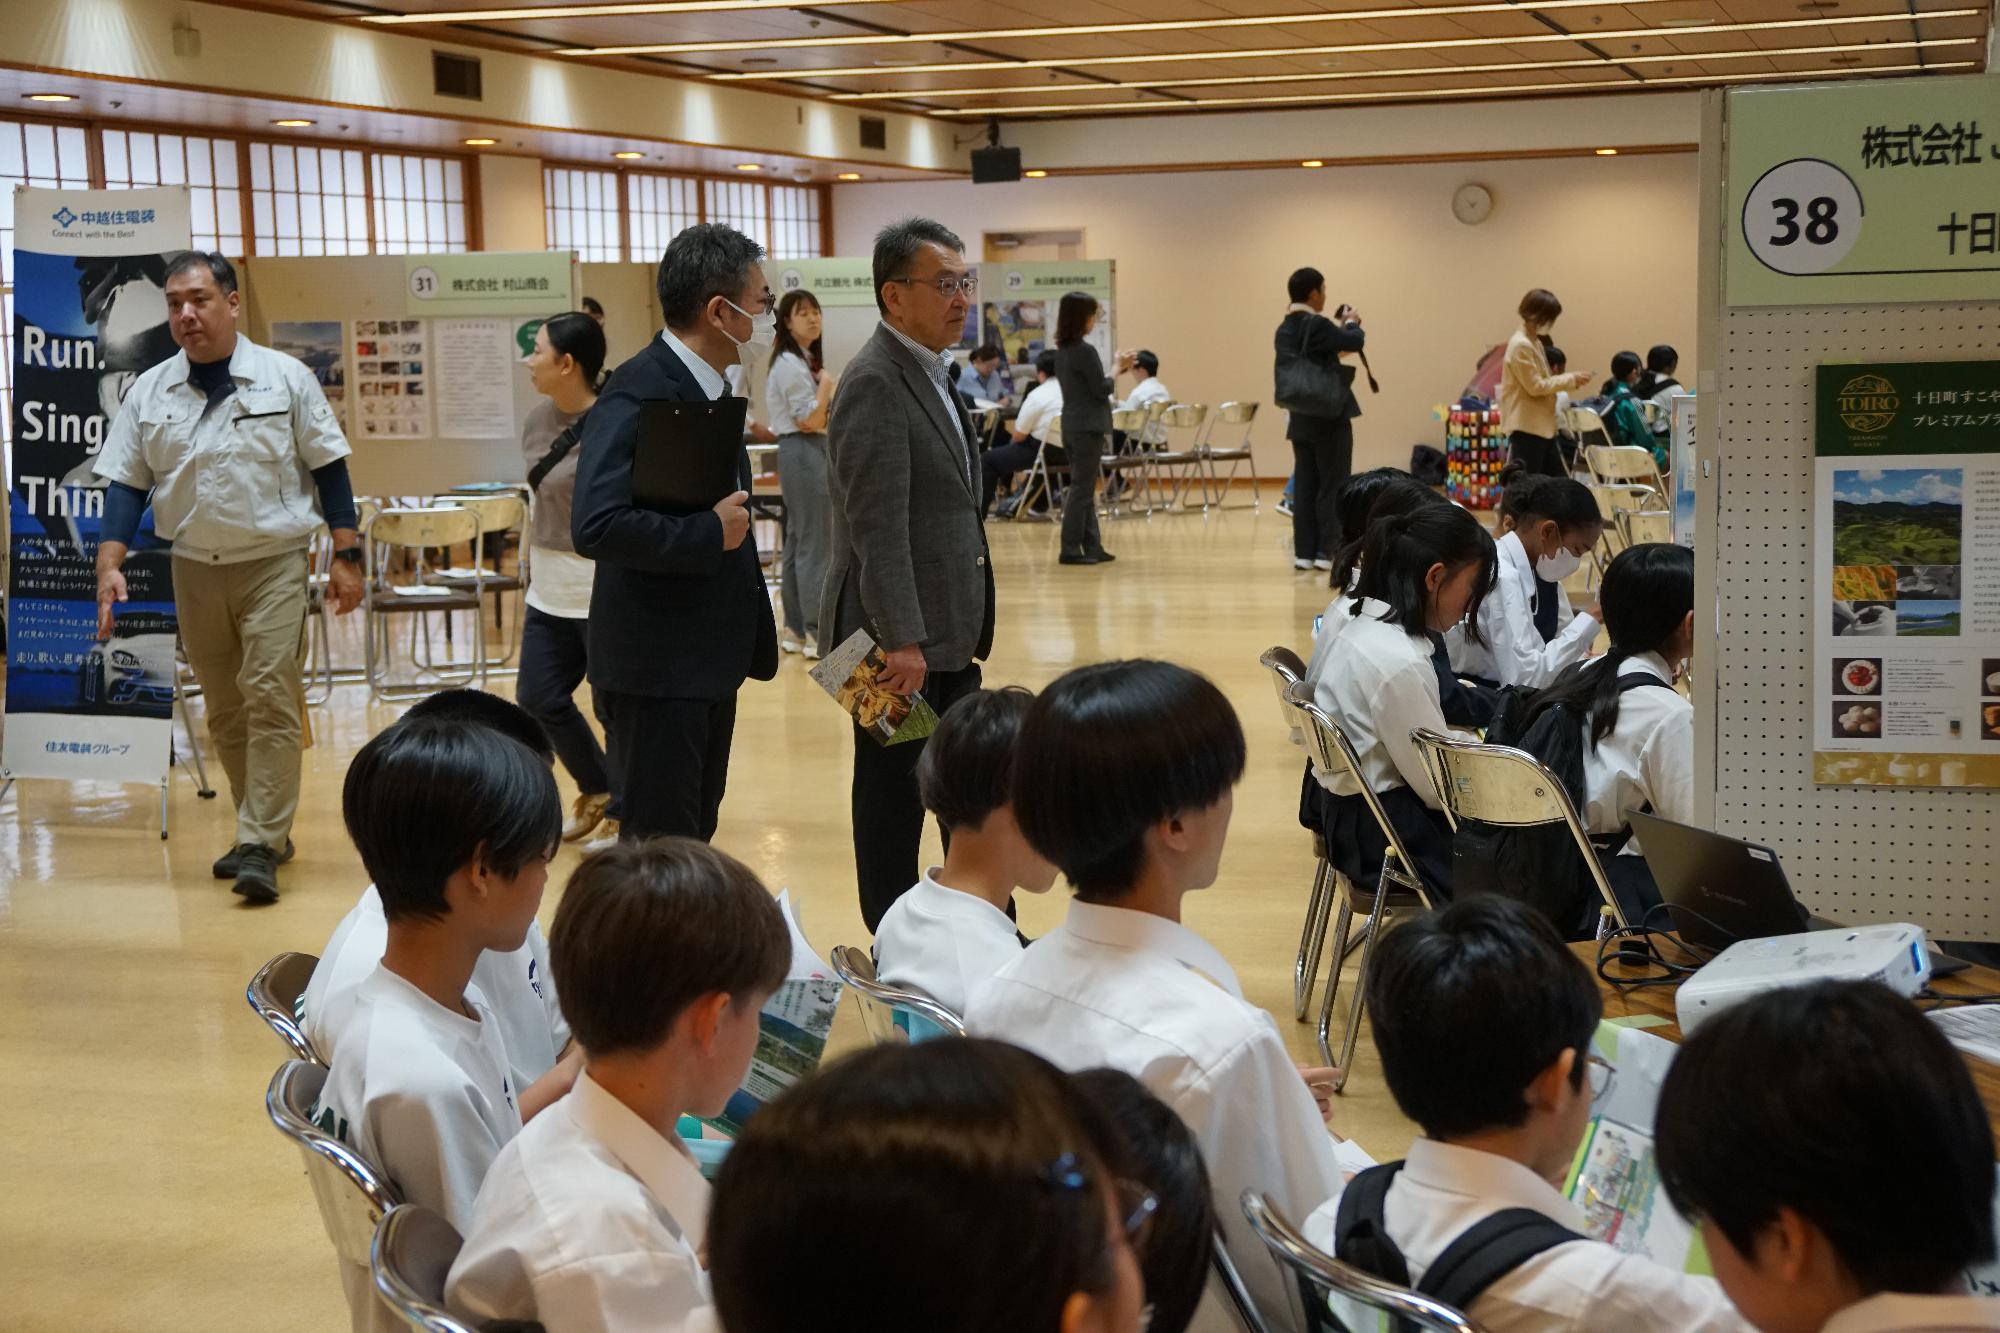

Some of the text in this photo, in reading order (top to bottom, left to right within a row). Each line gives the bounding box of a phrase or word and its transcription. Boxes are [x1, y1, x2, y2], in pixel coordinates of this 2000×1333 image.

[1861, 120, 1983, 169] 株式会社
[80, 208, 156, 225] 中越住電装
[1768, 196, 1839, 246] 38
[52, 229, 135, 239] Connect with the Best
[1937, 211, 2000, 256] 十日
[415, 277, 433, 292] 31
[452, 277, 550, 292] 株式会社 村山商会
[785, 276, 799, 288] 30
[1009, 276, 1021, 286] 29
[23, 325, 106, 370] Run.
[1837, 396, 1899, 412] TOIRO
[21, 400, 107, 455] Sing
[20, 474, 105, 519] Thin
